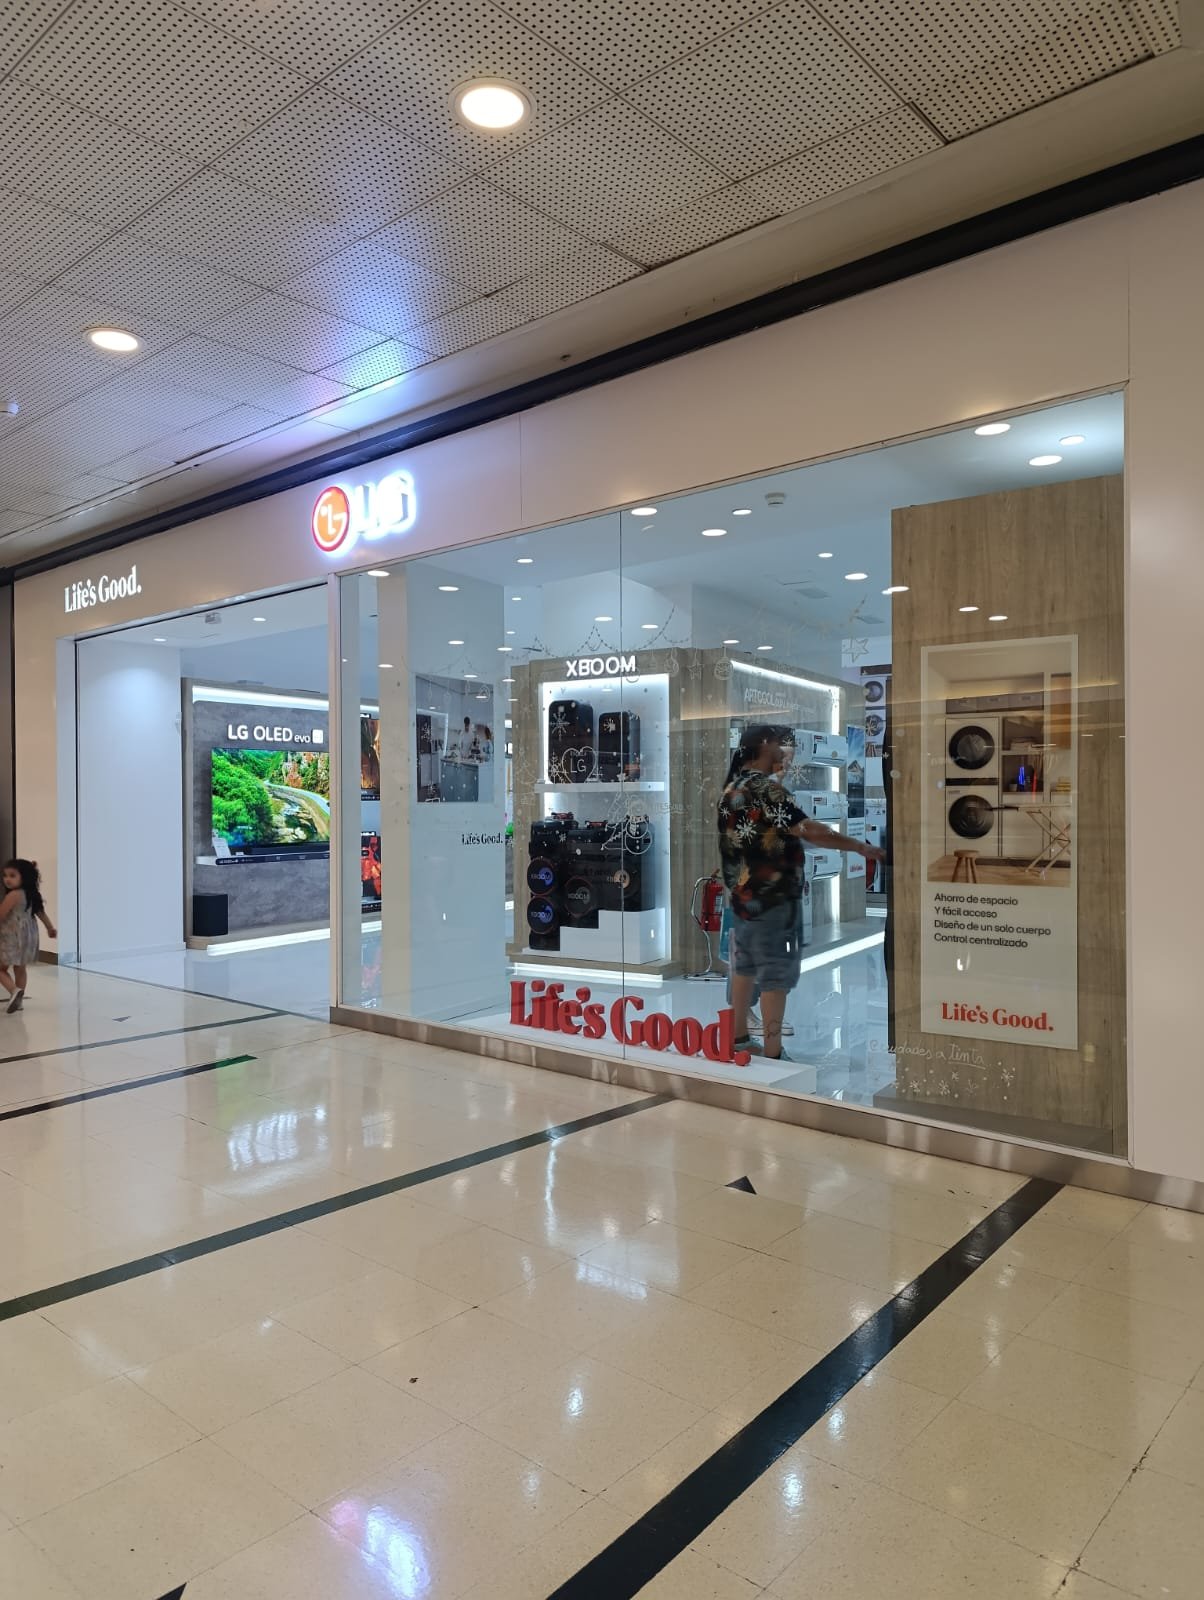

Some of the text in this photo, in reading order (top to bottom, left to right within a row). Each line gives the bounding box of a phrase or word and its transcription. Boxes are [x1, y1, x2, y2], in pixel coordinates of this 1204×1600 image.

[64, 564, 142, 613] Life's Good.
[565, 655, 636, 677] XBOOM
[227, 724, 249, 740] LG
[253, 725, 293, 741] OLED
[294, 734, 311, 743] evo
[570, 757, 587, 773] LG
[934, 893, 1019, 906] Ahorro de espacio
[934, 906, 998, 918] Y fácil acceso
[934, 919, 1051, 936] Diseño de un solo cuerpo
[934, 932, 1028, 948] Control centralizado
[510, 979, 752, 1066] Life's Good.
[942, 1002, 1054, 1031] Life's Good.
